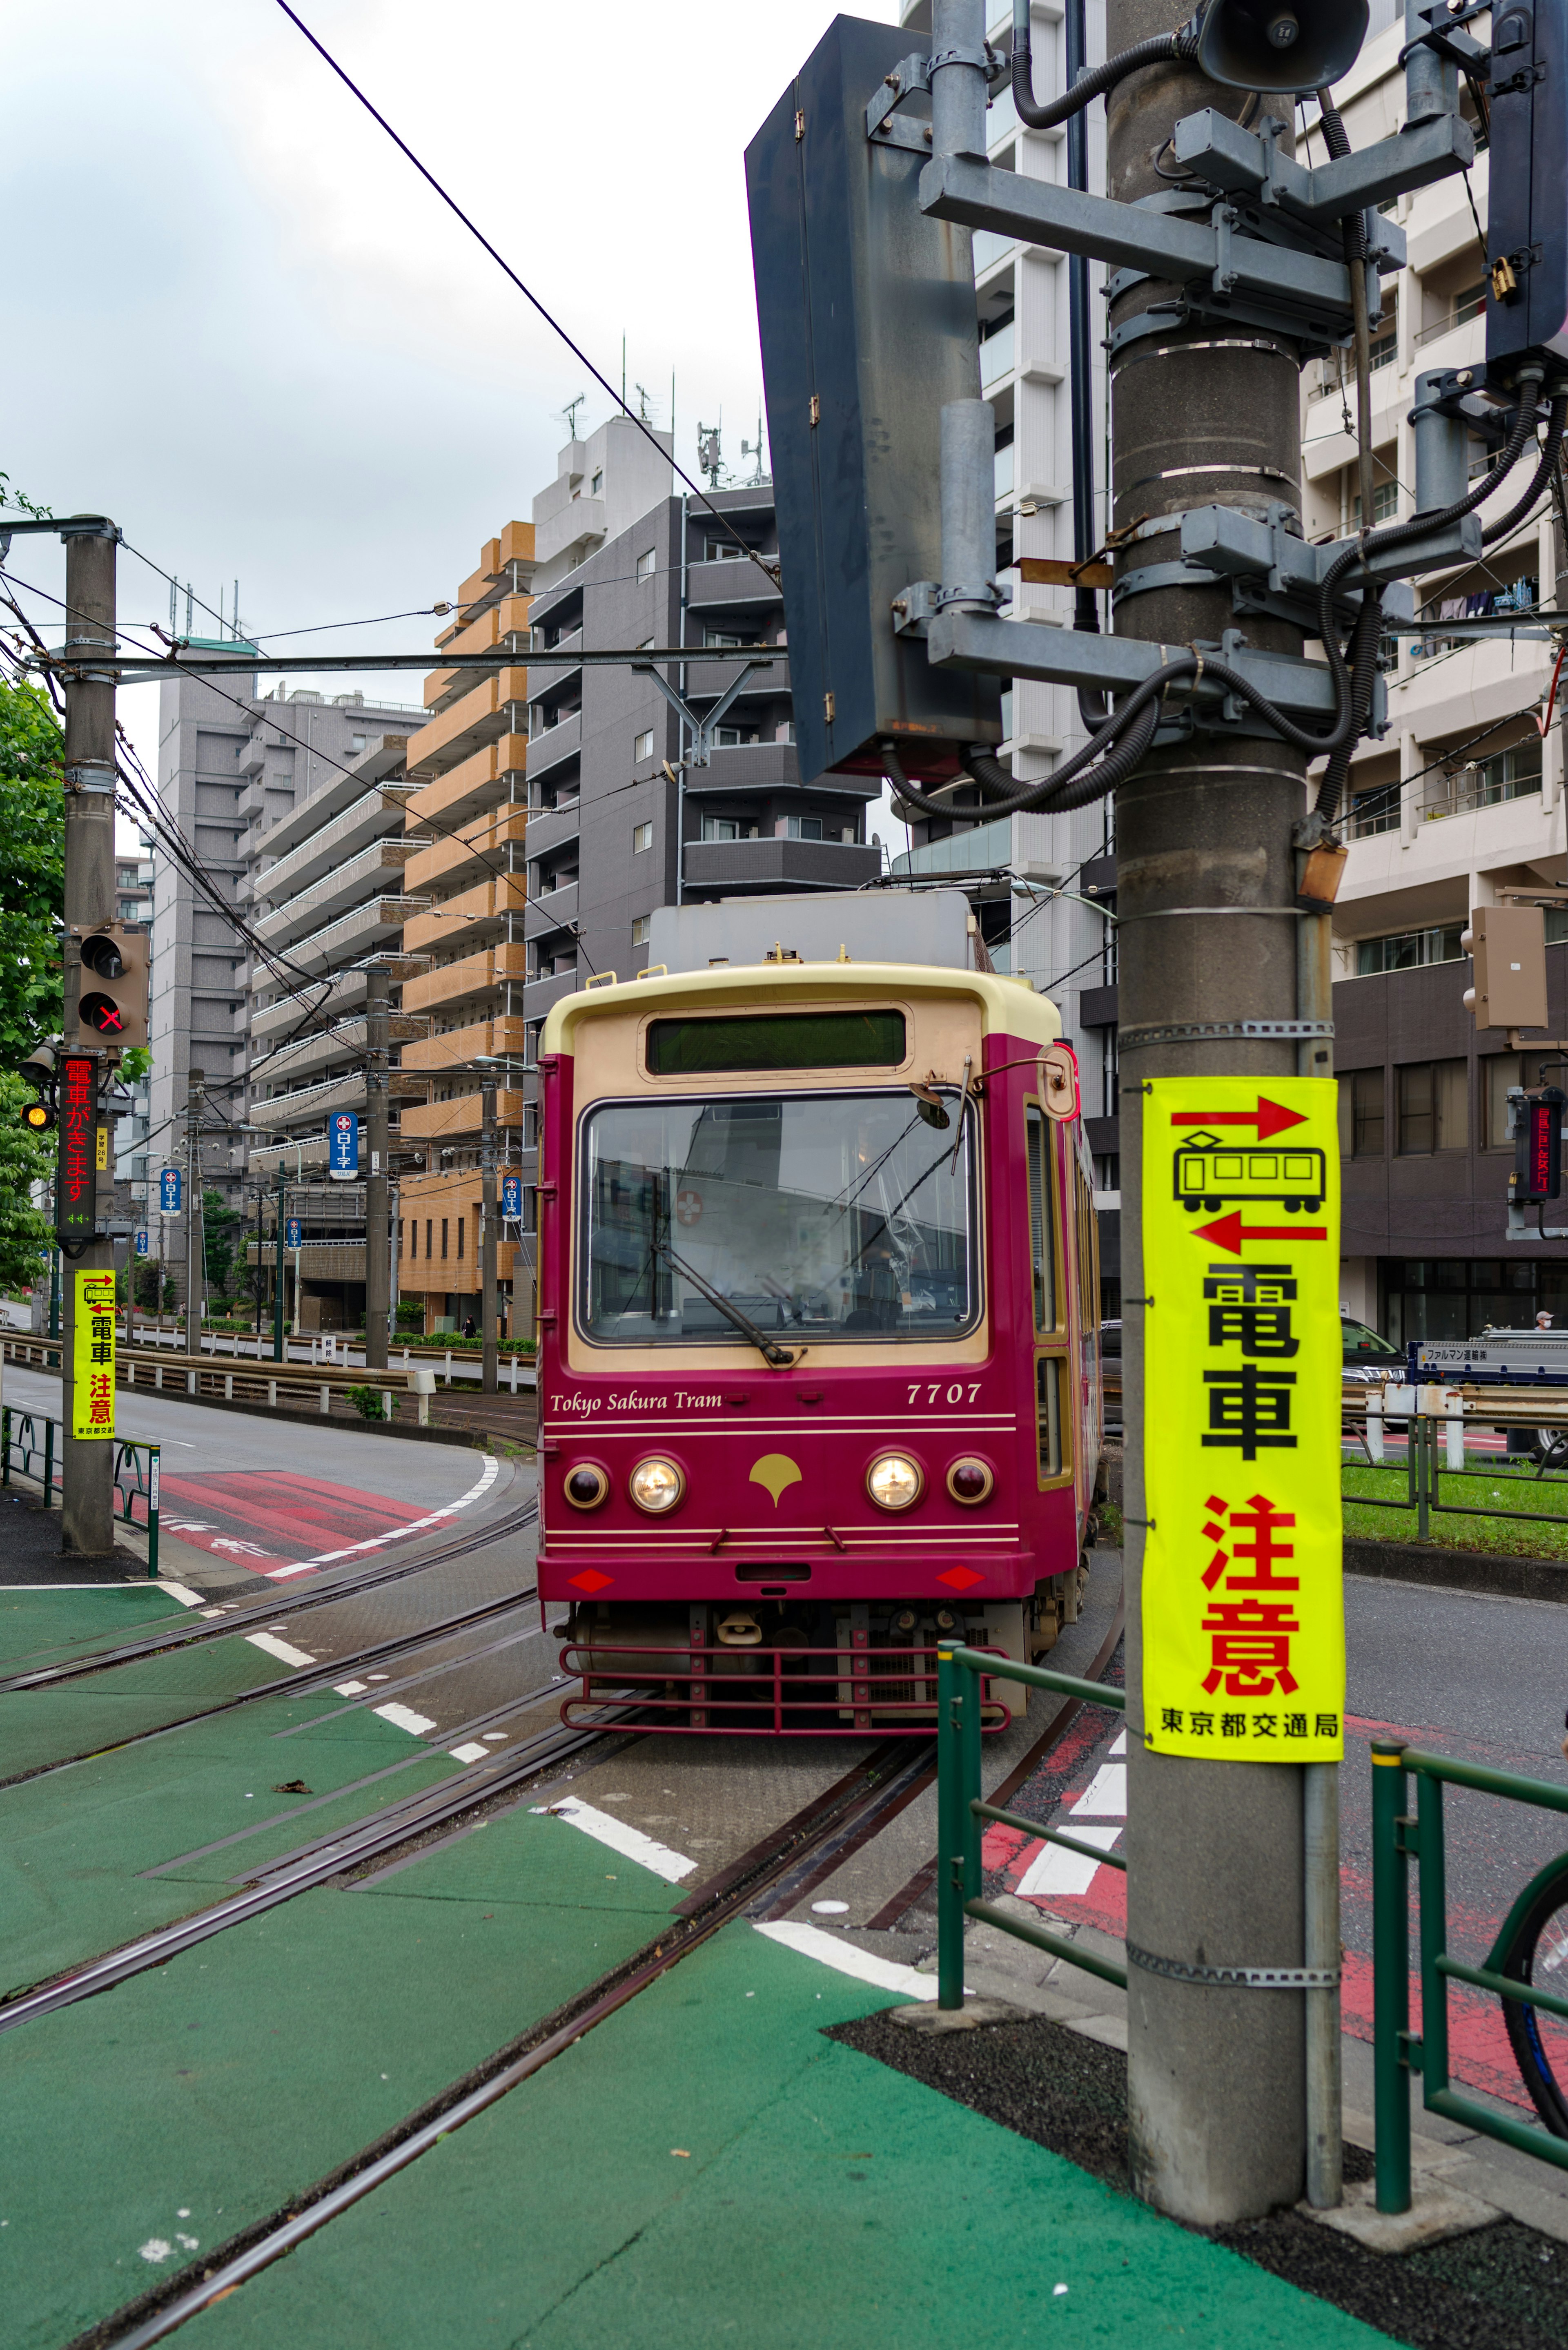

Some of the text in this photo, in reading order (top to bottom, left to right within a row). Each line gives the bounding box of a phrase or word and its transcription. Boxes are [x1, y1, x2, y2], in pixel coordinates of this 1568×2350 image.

[65, 1060, 91, 1202] 電車がきます
[97, 1135, 105, 1163] 学習26号
[337, 1132, 350, 1168] 白十字
[166, 1183, 176, 1209] 白十字
[325, 1340, 332, 1357] 解除
[89, 1316, 111, 1424] 電車 注意
[550, 1390, 722, 1418] Tokyo Sakura Tram
[907, 1384, 982, 1404] 7707
[1200, 1264, 1299, 1696] 電車 注意
[1161, 1708, 1339, 1739] 東京都交通局
